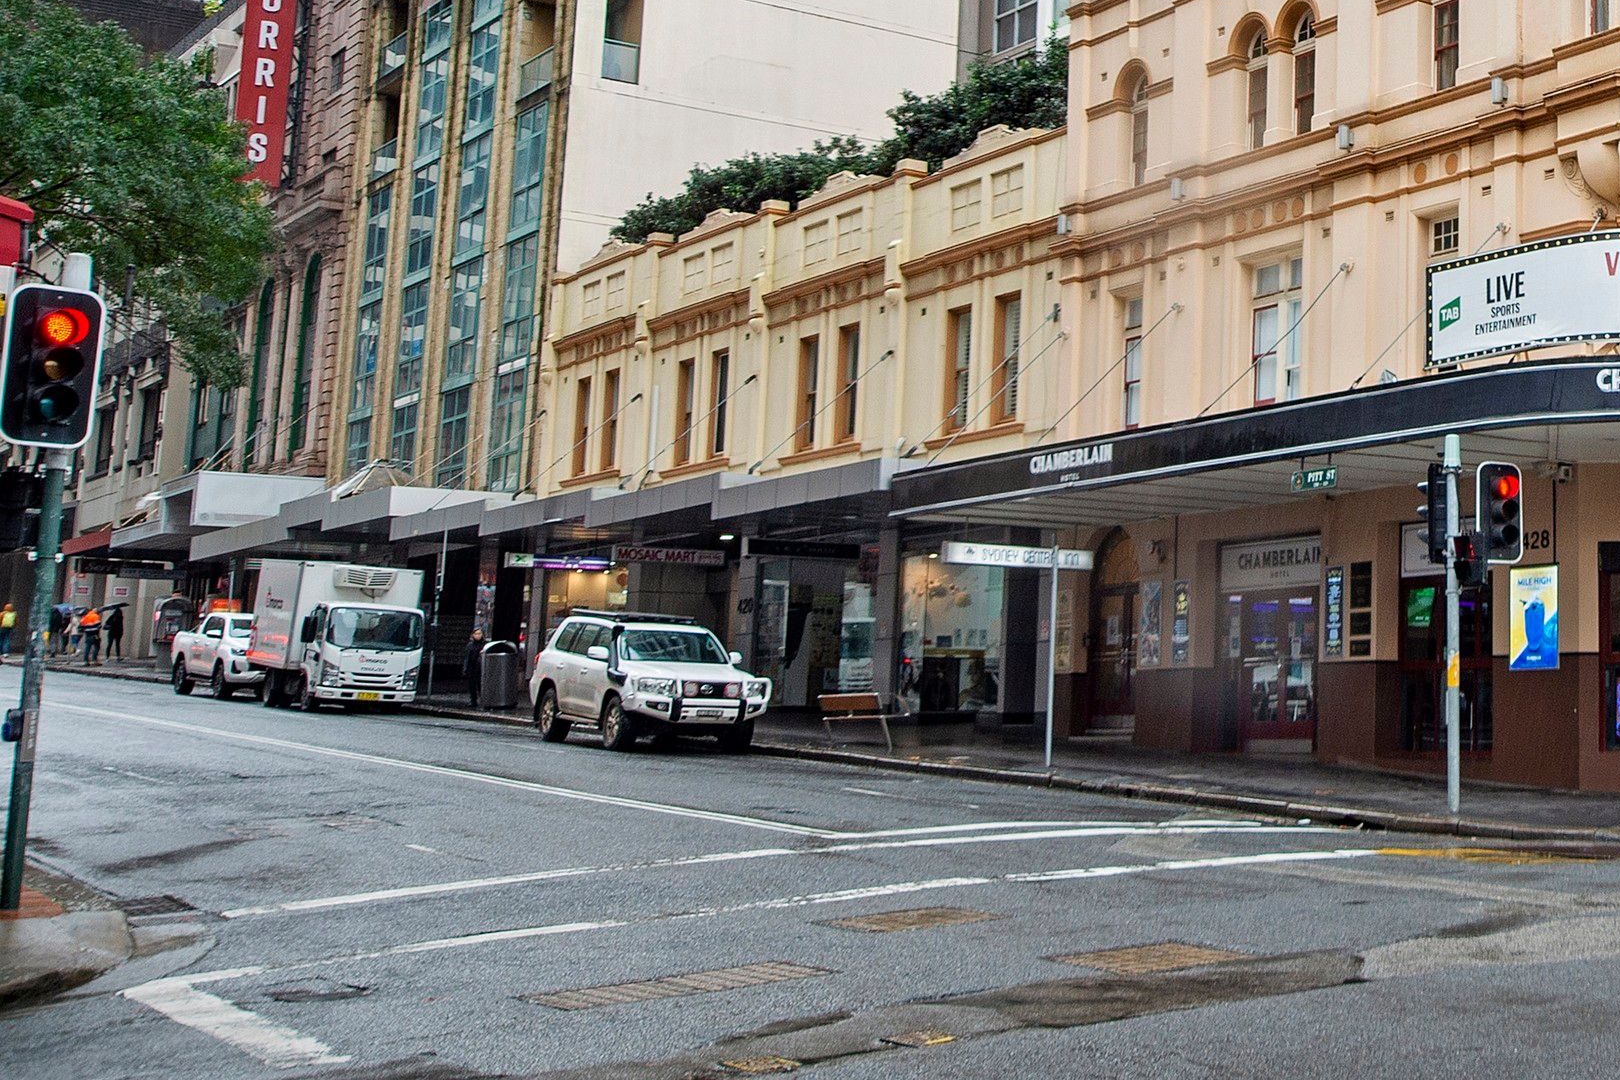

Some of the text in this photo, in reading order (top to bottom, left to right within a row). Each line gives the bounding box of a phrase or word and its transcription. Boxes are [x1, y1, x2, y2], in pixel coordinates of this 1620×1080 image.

[1485, 271, 1526, 304] LIVE
[1440, 306, 1460, 321] TAB
[1490, 302, 1521, 319] SPORTS
[1474, 313, 1537, 336] ENTERTAINMENT
[1029, 443, 1114, 474] CHAMBERLAIN
[1307, 469, 1335, 483] PITT ST
[1523, 529, 1550, 550] 428
[617, 547, 663, 560] MOSAIC
[664, 550, 697, 562] MART
[982, 548, 1019, 561] SYDNEY
[1517, 576, 1552, 587] MILE HIGH
